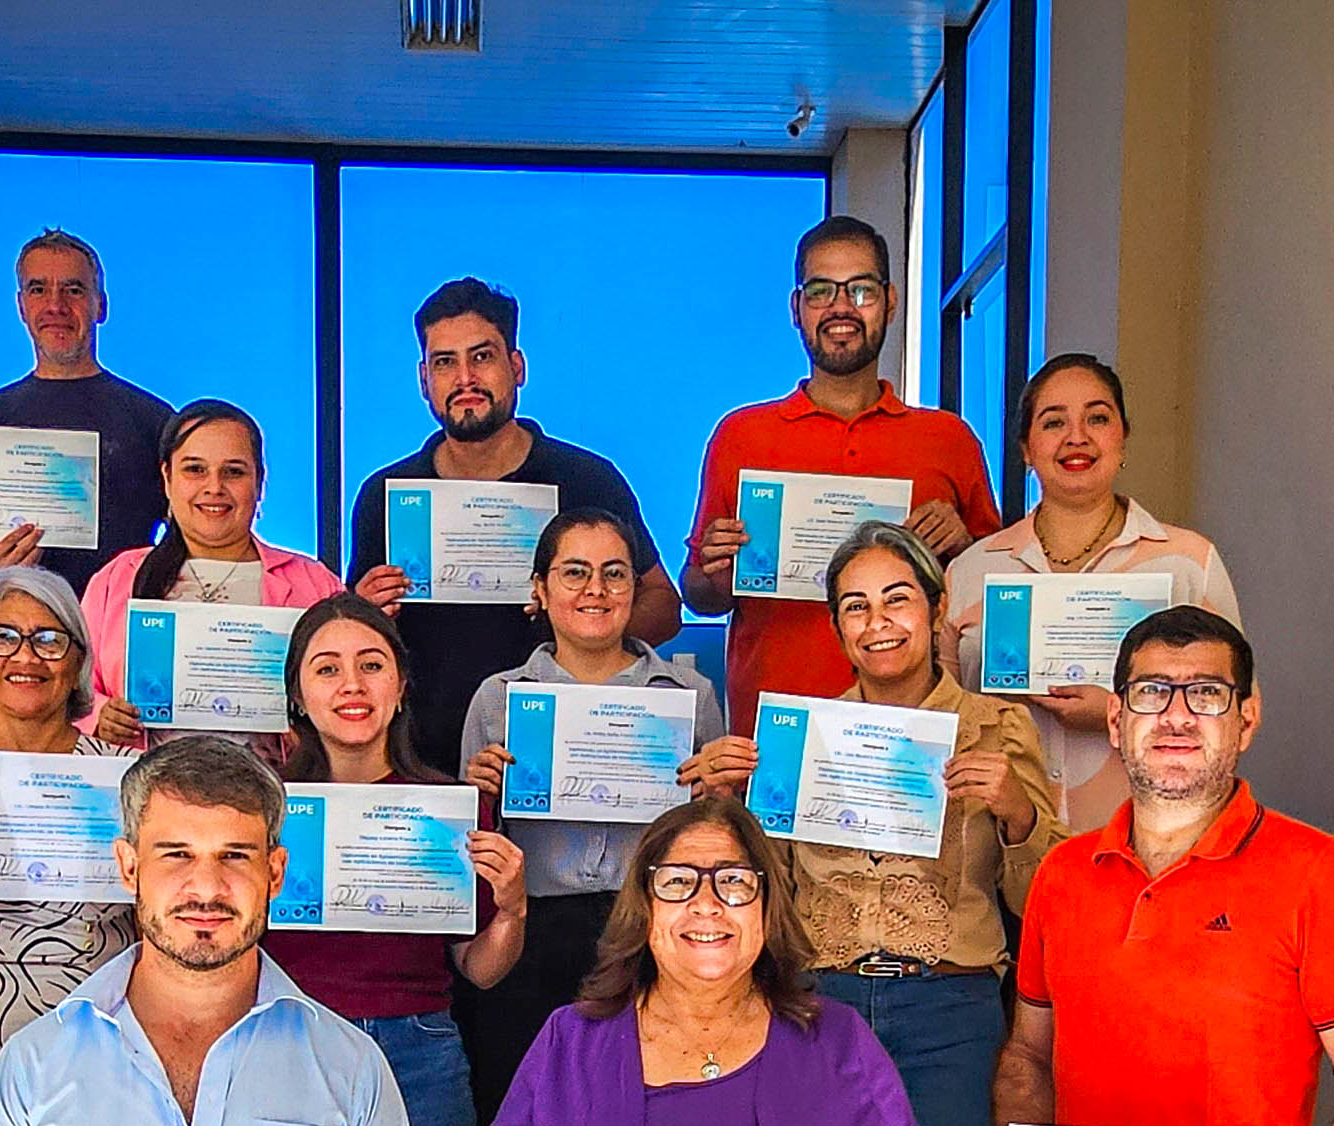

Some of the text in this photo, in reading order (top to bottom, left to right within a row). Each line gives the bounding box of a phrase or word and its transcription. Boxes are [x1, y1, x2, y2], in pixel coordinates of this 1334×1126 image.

[752, 488, 774, 499] UPE
[400, 496, 422, 506] UPE
[999, 591, 1023, 600] UPE
[142, 618, 165, 628] UPE
[522, 700, 546, 711] UPE
[773, 713, 798, 727] UPE
[288, 804, 315, 815] UPE
